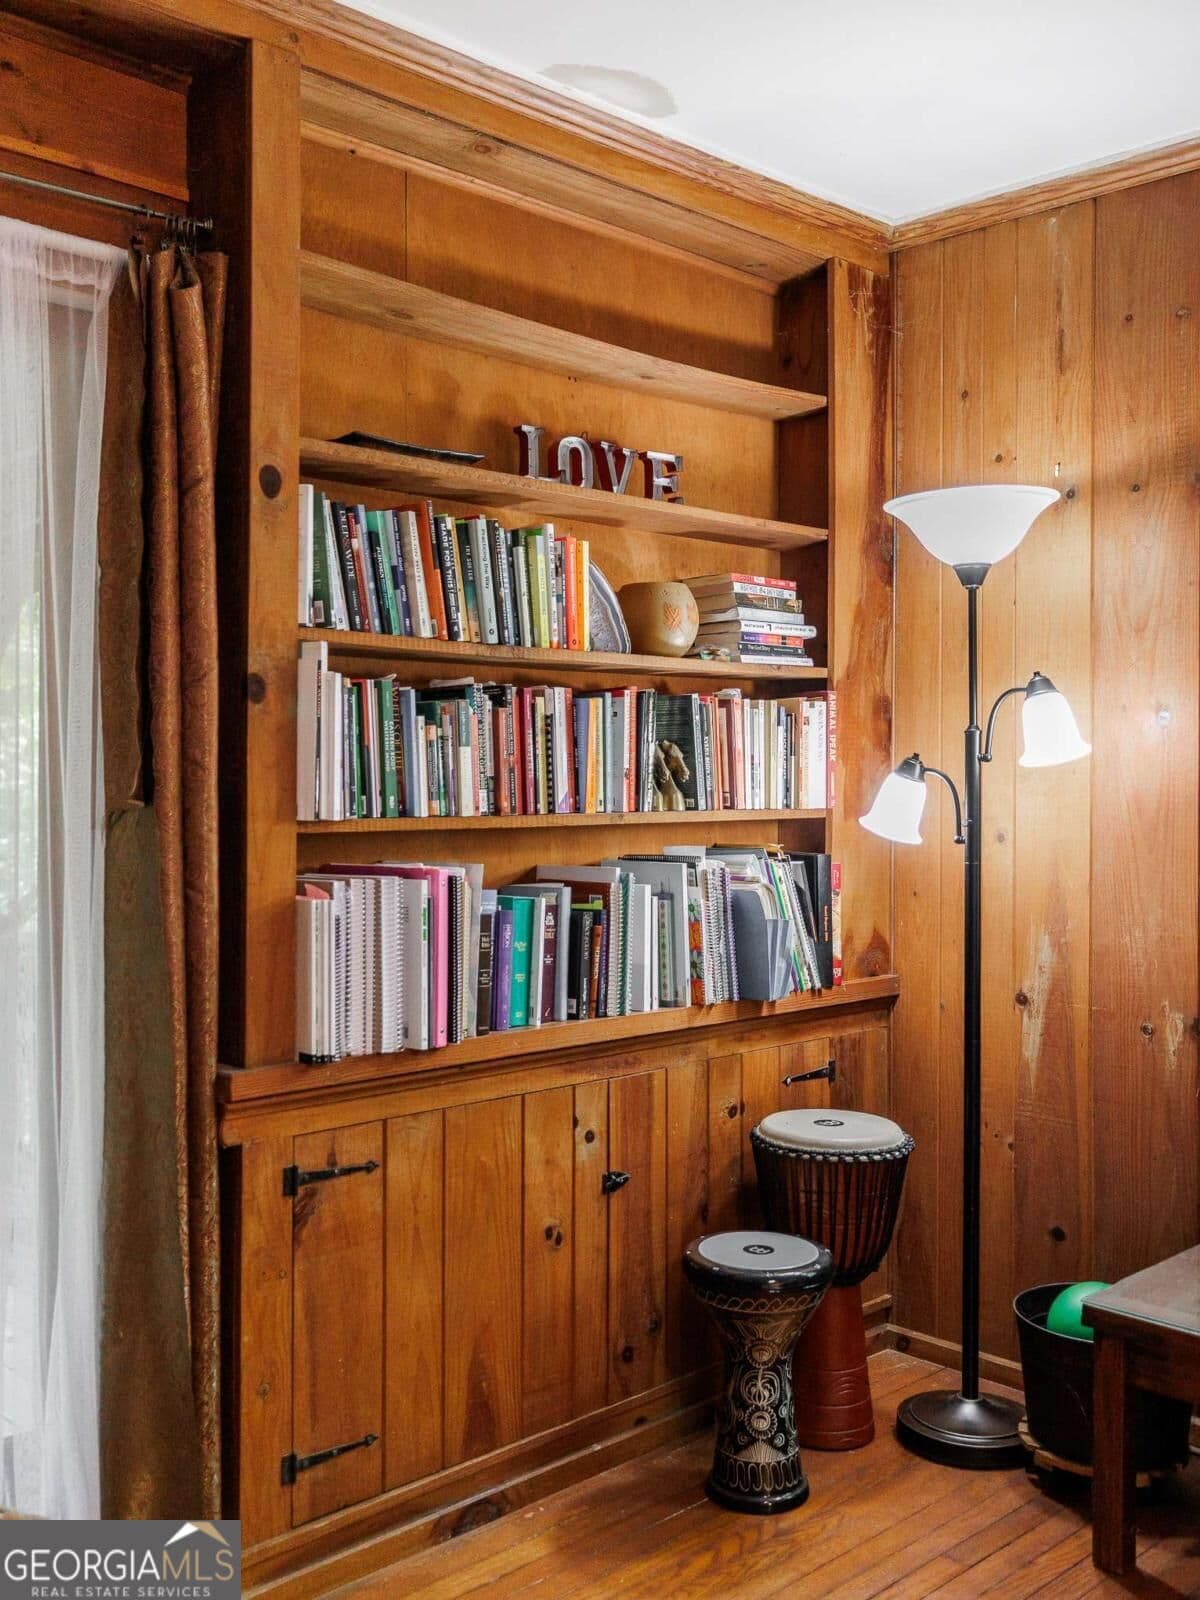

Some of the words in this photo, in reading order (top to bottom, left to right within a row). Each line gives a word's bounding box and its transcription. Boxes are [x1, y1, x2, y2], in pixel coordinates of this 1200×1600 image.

[513, 424, 684, 504] LOVE
[339, 510, 350, 535] DEEP
[440, 523, 449, 550] MADE
[344, 550, 354, 578] WIDE
[830, 693, 838, 729] ANIMAL
[830, 736, 838, 762] SPEAK
